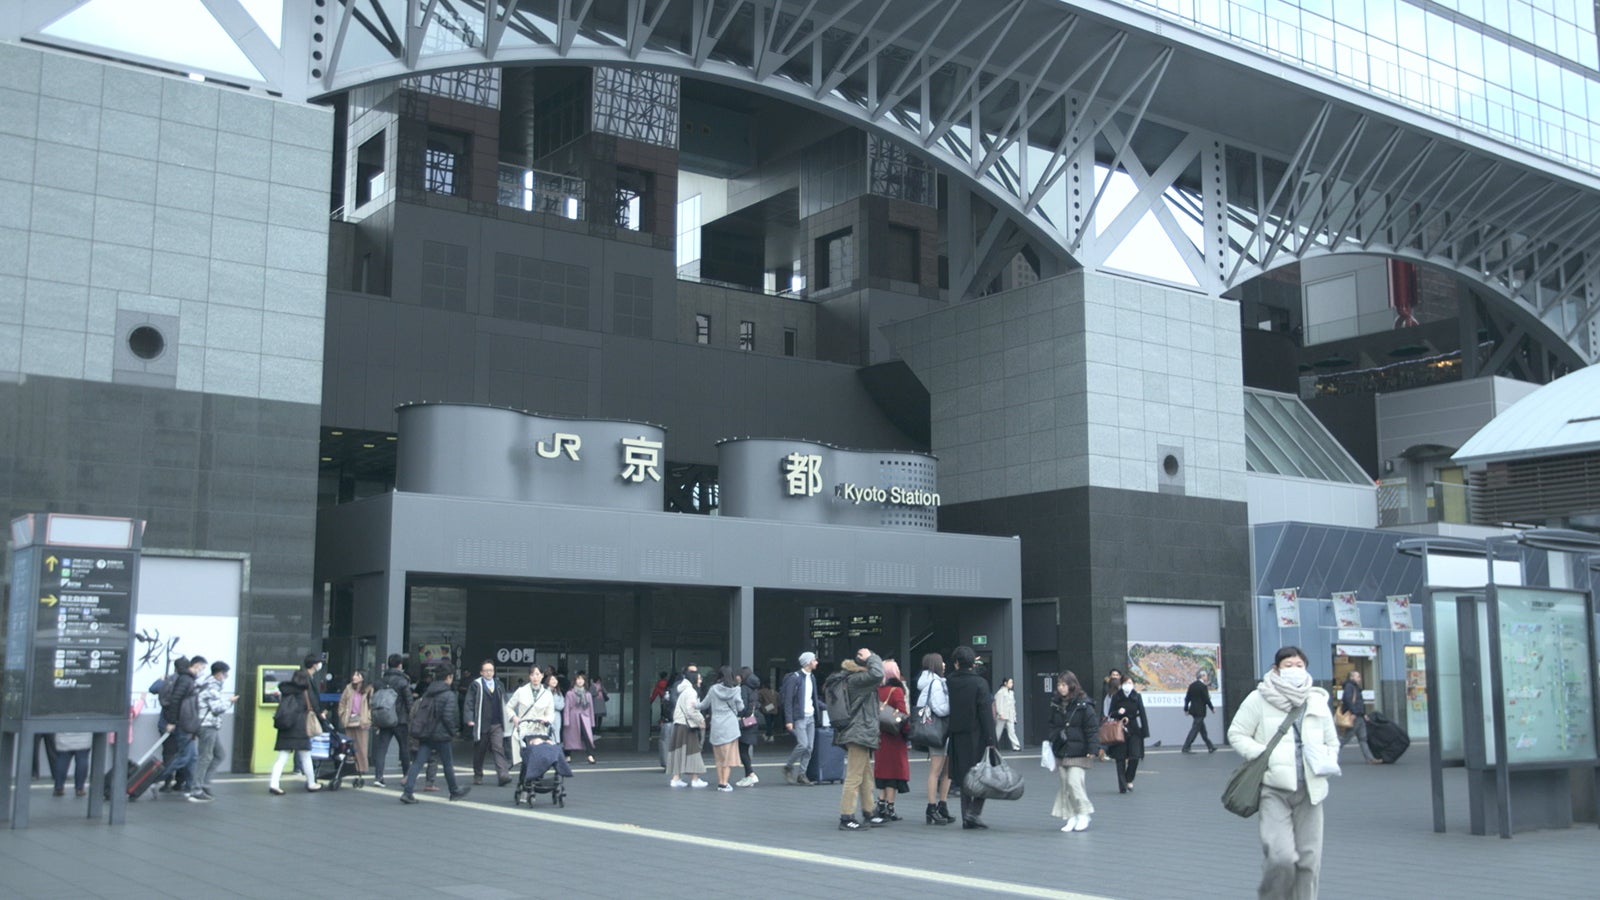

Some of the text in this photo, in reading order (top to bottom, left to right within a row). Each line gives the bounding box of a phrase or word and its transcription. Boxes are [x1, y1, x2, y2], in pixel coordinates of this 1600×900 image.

[537, 432, 581, 461] JR
[621, 436, 823, 497] 京 都
[844, 482, 941, 507] Kyoto Station
[1147, 696, 1172, 704] KYOTO
